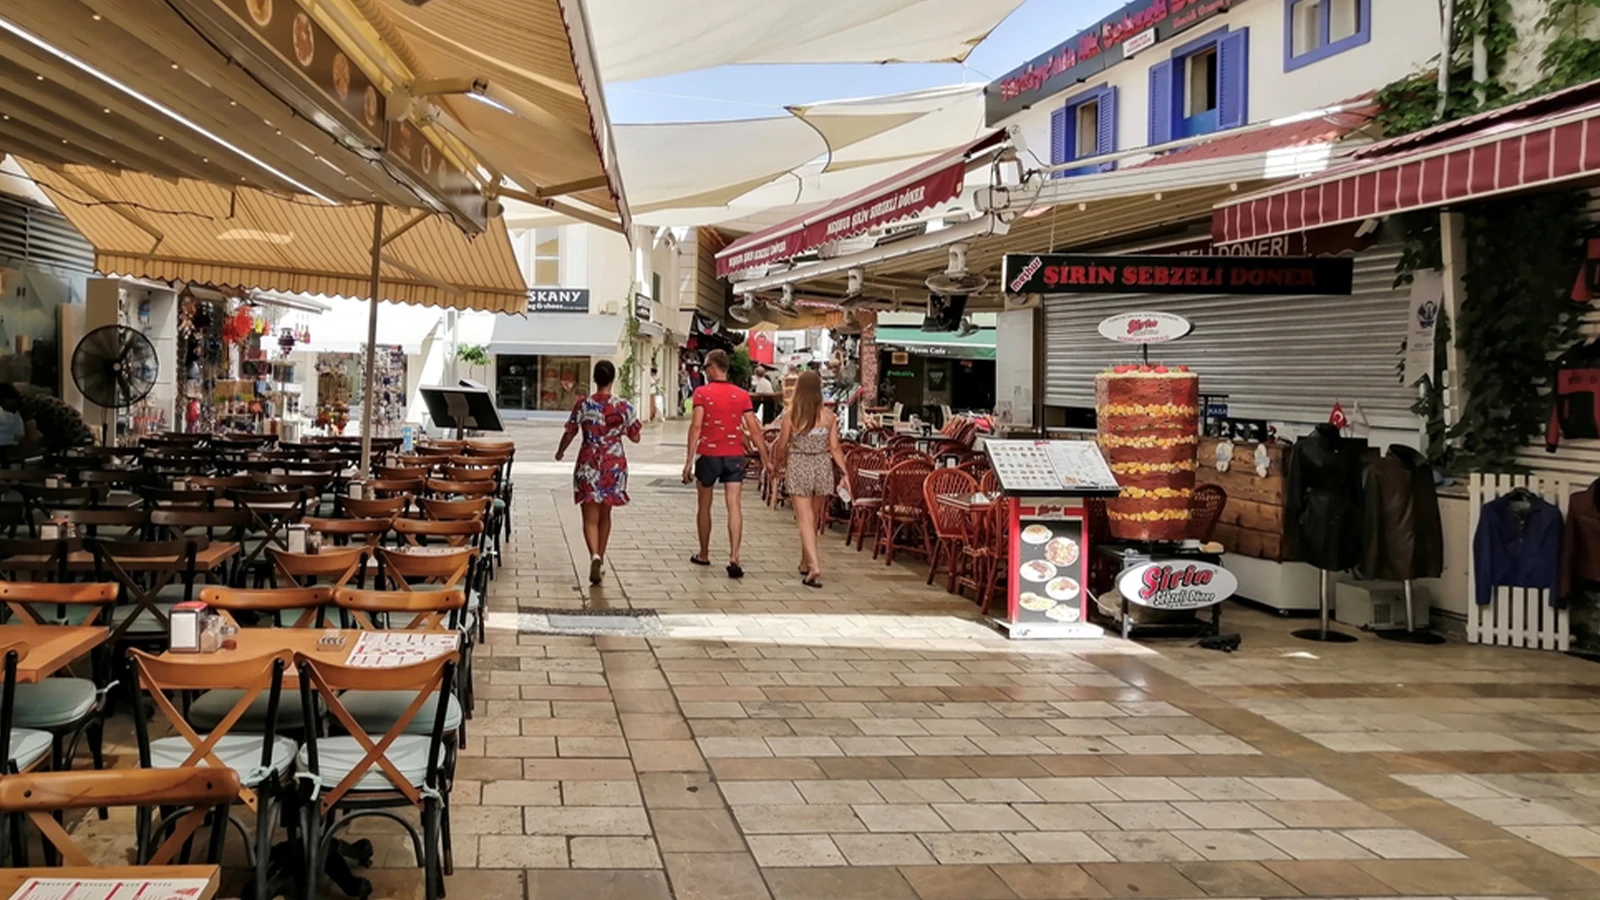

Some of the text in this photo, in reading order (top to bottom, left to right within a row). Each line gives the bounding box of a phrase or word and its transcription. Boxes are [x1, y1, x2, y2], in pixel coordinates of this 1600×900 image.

[1043, 262, 1117, 288] ŞİRİN
[1122, 262, 1224, 286] SEBZELİ
[528, 291, 581, 302] SKANY
